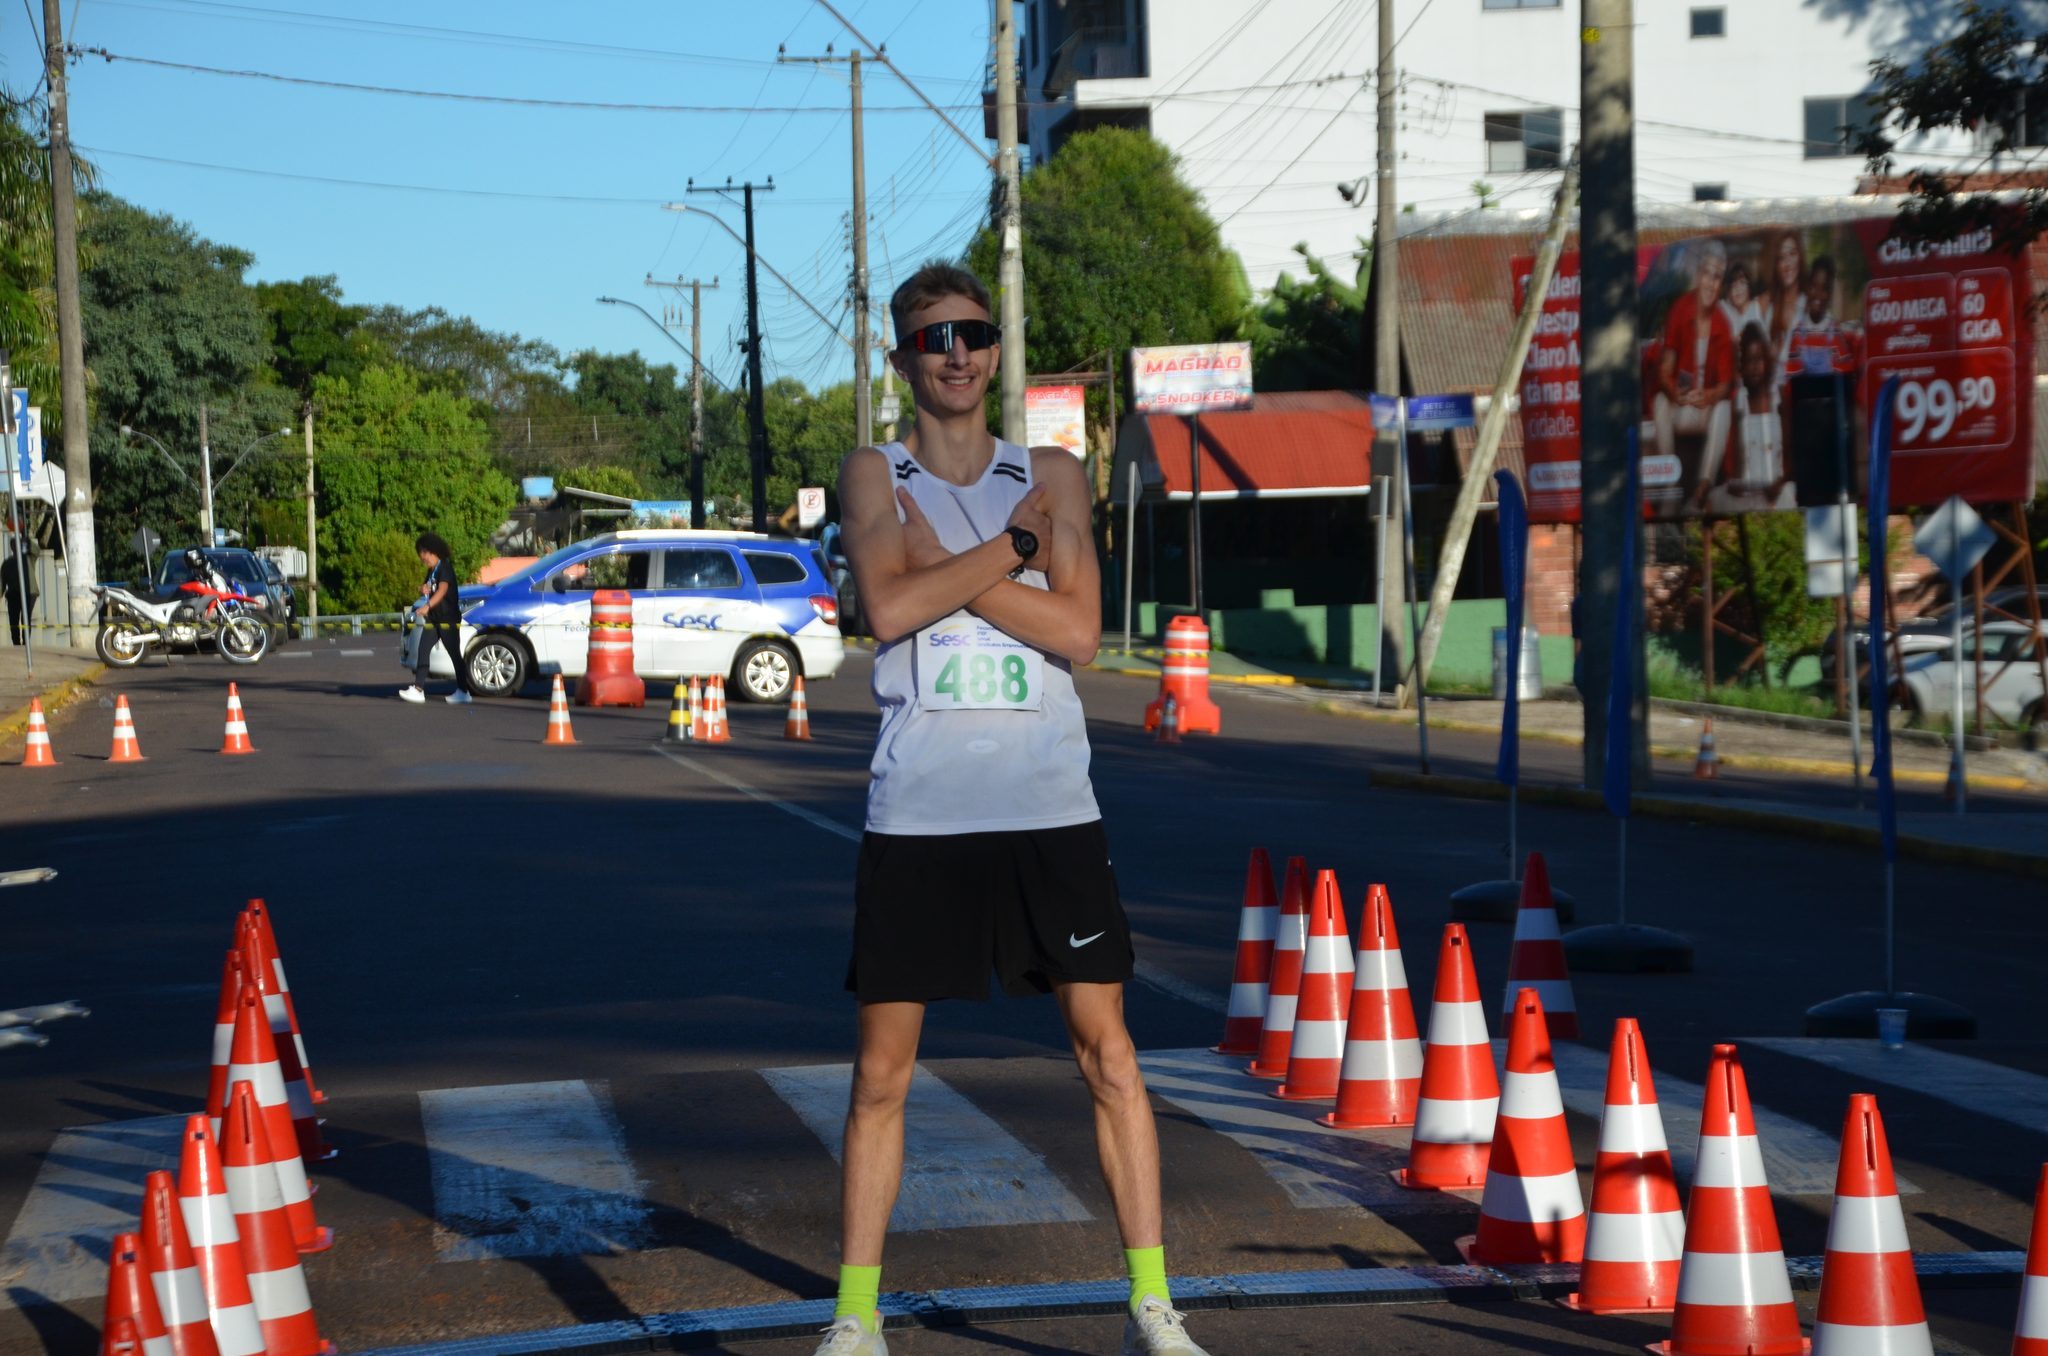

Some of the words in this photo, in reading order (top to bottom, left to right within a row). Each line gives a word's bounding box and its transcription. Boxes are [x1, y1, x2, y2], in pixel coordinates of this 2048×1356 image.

[1870, 301, 1901, 323] 600
[1902, 297, 1947, 319] MEGA
[1962, 293, 1986, 316] 60
[1961, 319, 2003, 342] GIGA
[934, 653, 1029, 703] 488
